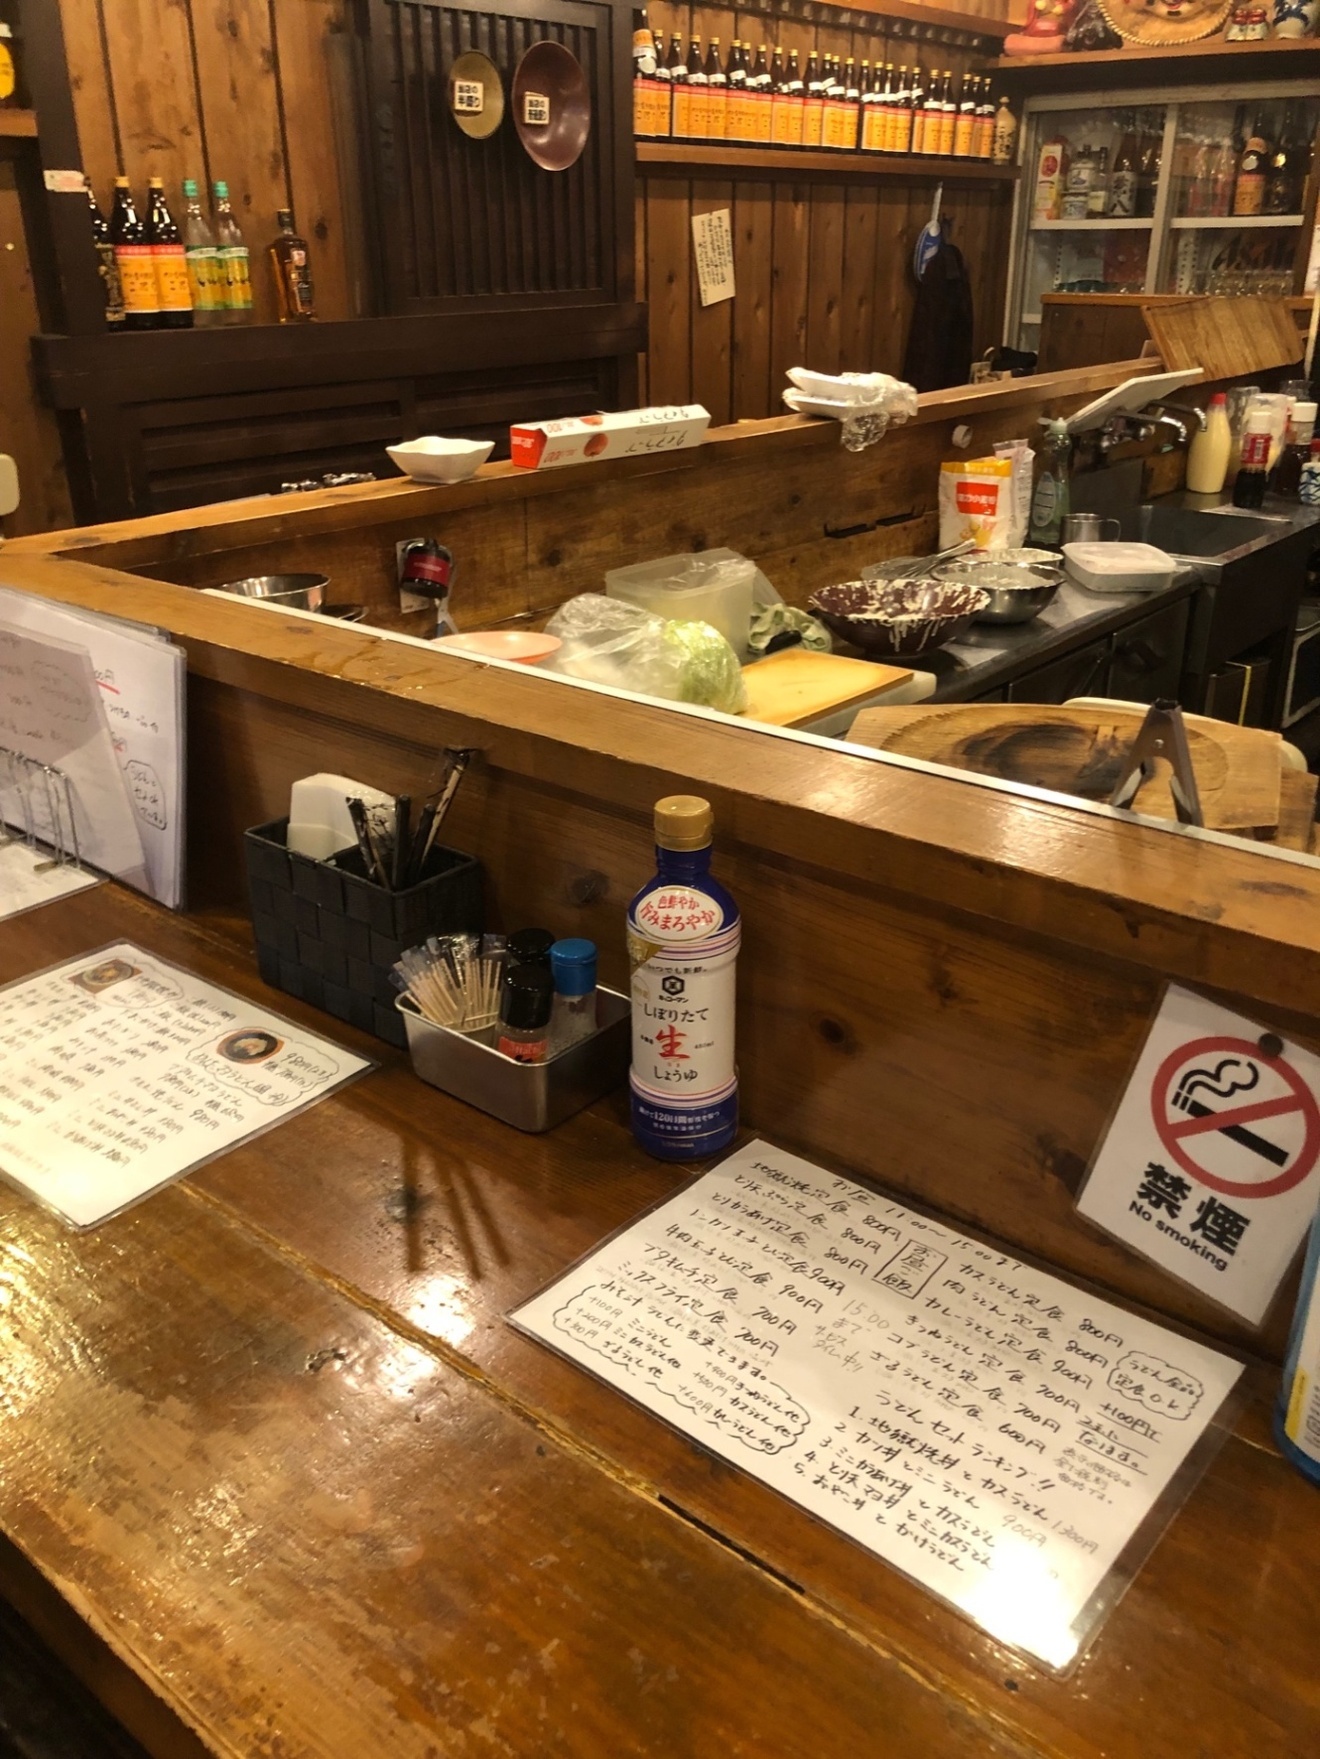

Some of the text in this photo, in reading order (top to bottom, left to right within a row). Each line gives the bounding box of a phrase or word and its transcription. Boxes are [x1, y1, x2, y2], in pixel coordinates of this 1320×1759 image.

[658, 896, 699, 910] 色鮮やか
[644, 1003, 709, 1023] しぼりたて
[655, 1024, 691, 1060] 生
[654, 1065, 698, 1083] しょうゆ
[1136, 1161, 1251, 1257] 禁煙
[840, 1227, 881, 1254] 800円
[861, 1214, 901, 1241] 800円
[1128, 1200, 1229, 1272] No smoking
[823, 1246, 868, 1275] 800円
[807, 1267, 845, 1296] 900円
[778, 1284, 823, 1313] 900円
[751, 1305, 797, 1335] 700円
[1078, 1318, 1123, 1347] 800円
[733, 1326, 779, 1357] 700円
[1064, 1339, 1108, 1368] 800円
[1051, 1359, 1092, 1389] 900円
[1035, 1383, 1080, 1413] 700円
[1013, 1402, 1060, 1433] 700円
[997, 1422, 1046, 1454] 600円
